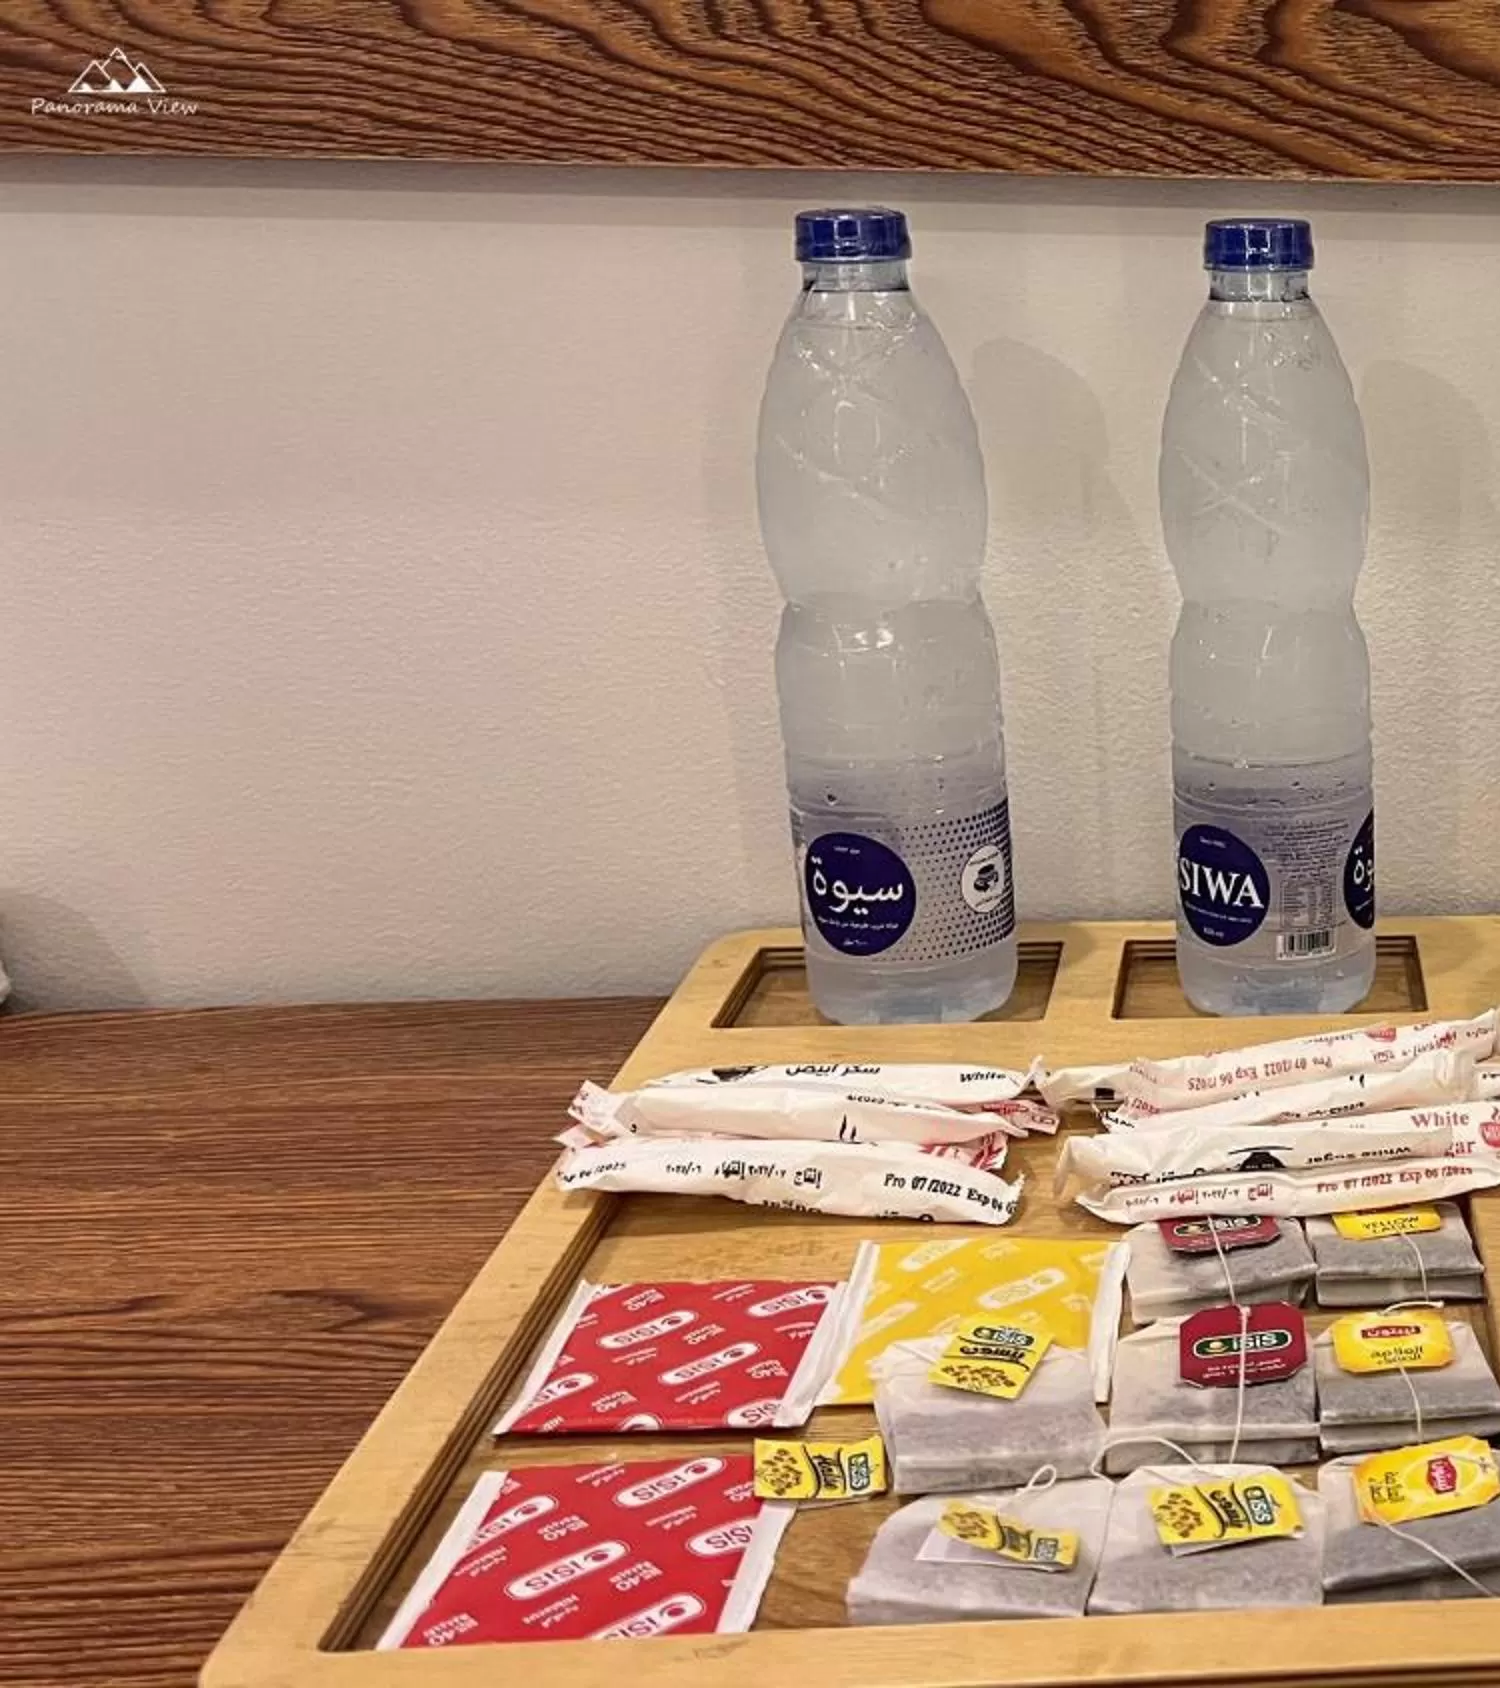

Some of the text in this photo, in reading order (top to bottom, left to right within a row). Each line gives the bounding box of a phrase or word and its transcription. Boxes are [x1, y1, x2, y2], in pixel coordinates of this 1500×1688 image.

[811, 854, 904, 916] سيوة
[1179, 856, 1265, 909] SIWA
[960, 1071, 1007, 1083] White
[1410, 1110, 1470, 1129] White
[884, 1173, 906, 1189] Pro
[966, 1187, 990, 1206] Exp
[1317, 1181, 1339, 1193] Pro
[1400, 1169, 1423, 1184] Exp
